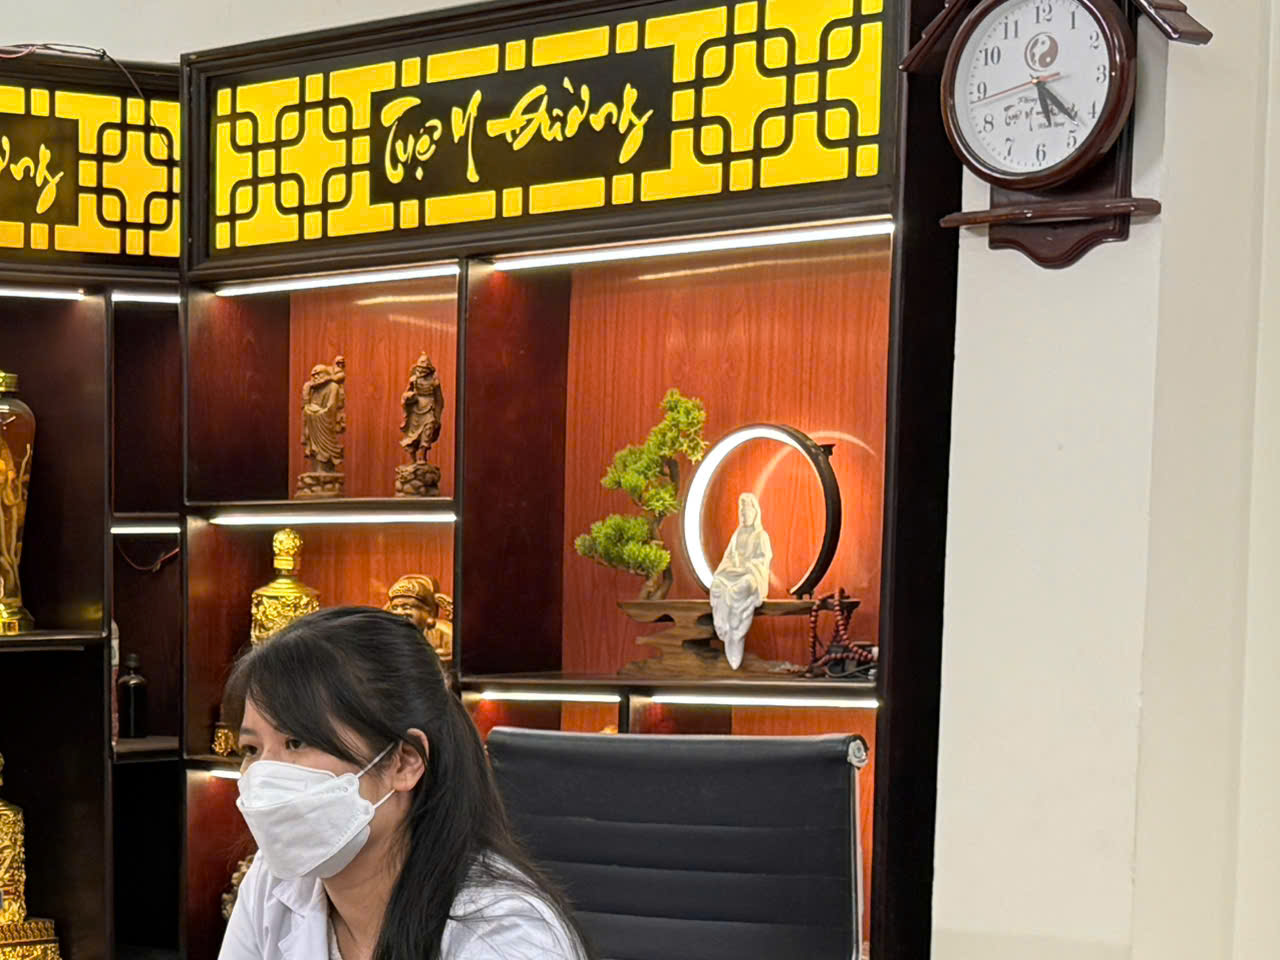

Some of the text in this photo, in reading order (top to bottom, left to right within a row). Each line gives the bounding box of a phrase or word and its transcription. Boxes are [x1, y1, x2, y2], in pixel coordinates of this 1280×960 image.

[1033, 5, 1053, 24] 12
[1070, 10, 1077, 30] 1
[1003, 16, 1019, 40] 11
[1089, 33, 1100, 50] 2
[983, 47, 1001, 66] 10
[1096, 65, 1107, 83] 3
[977, 82, 987, 101] 9
[1088, 100, 1097, 118] 4
[983, 113, 994, 133] 8
[381, 96, 442, 184] Tuệ
[1005, 138, 1015, 158] 7
[1066, 130, 1077, 149] 5
[1036, 143, 1046, 162] 6
